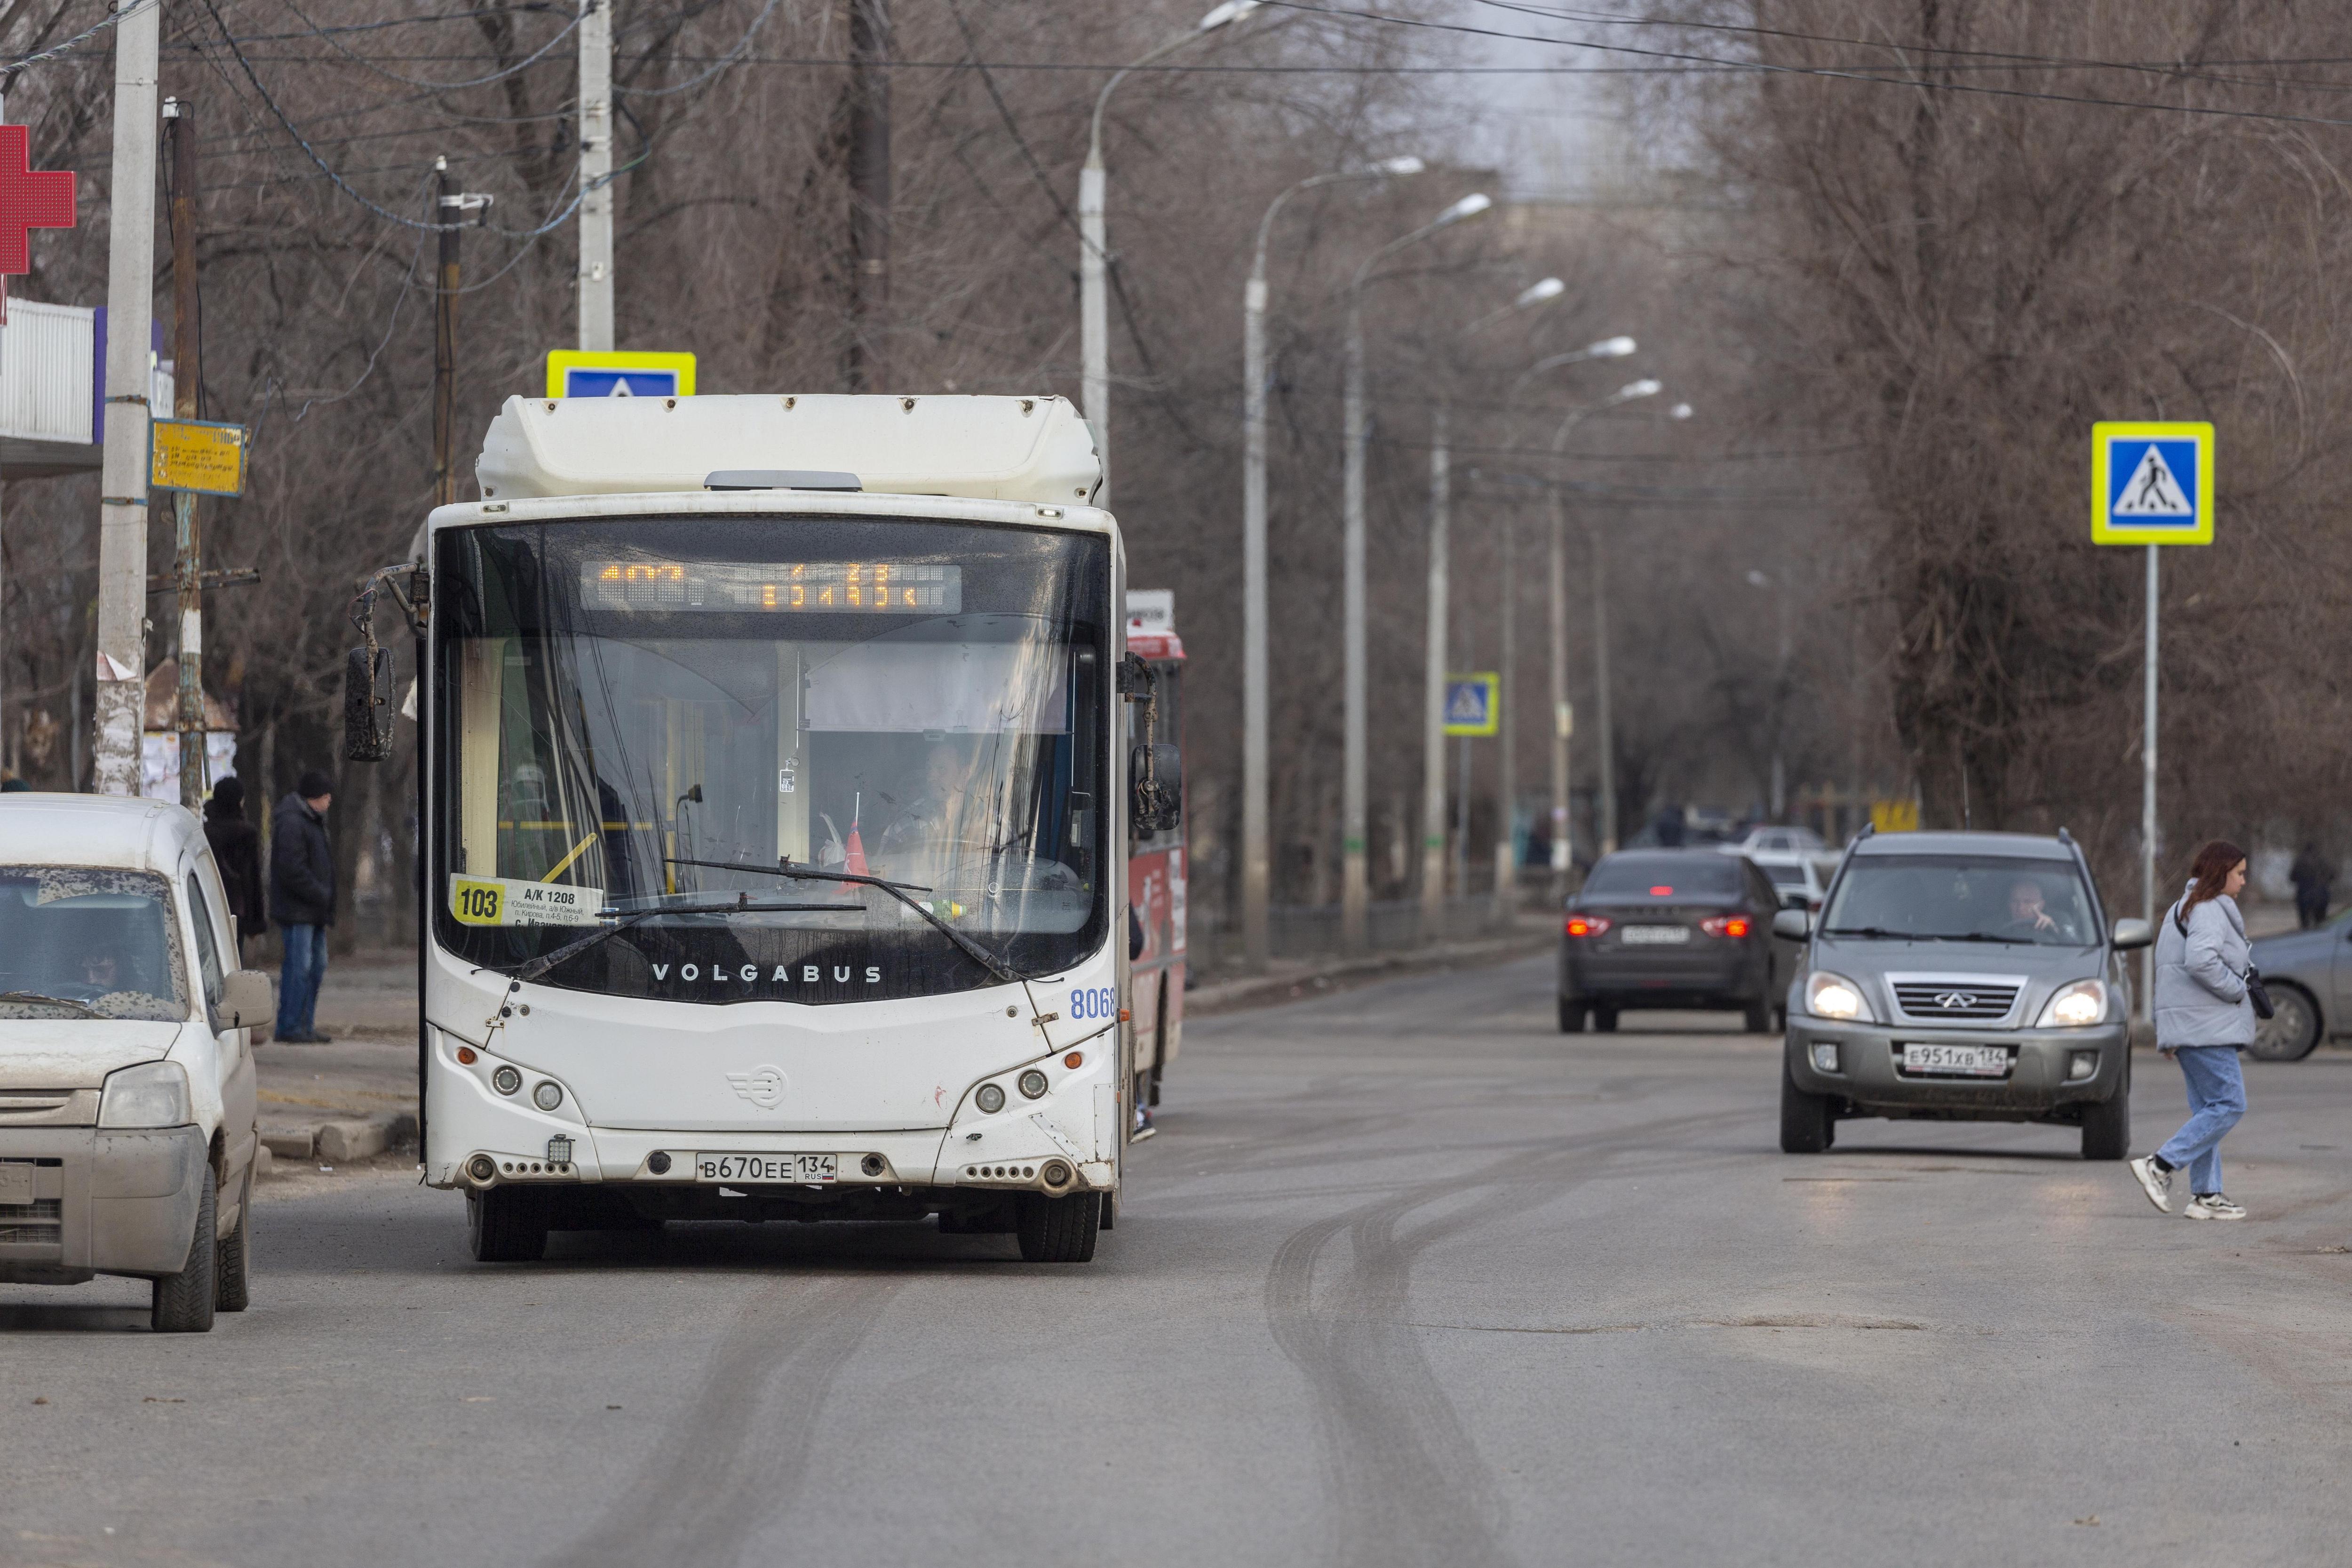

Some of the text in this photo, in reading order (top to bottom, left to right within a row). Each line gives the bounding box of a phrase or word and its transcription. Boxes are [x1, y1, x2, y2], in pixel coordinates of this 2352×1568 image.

[461, 888, 498, 918] 103
[524, 888, 575, 904] А/К 1208
[511, 900, 547, 911] Юбилейный,
[560, 905, 584, 915] Южный,
[522, 909, 544, 919] Кирова,
[652, 963, 881, 982] VOLGABUS
[1071, 987, 1115, 1019] 8068
[1910, 1048, 2003, 1065] Е951ХВ 134
[704, 1156, 831, 1178] В670ЕЕ 134
